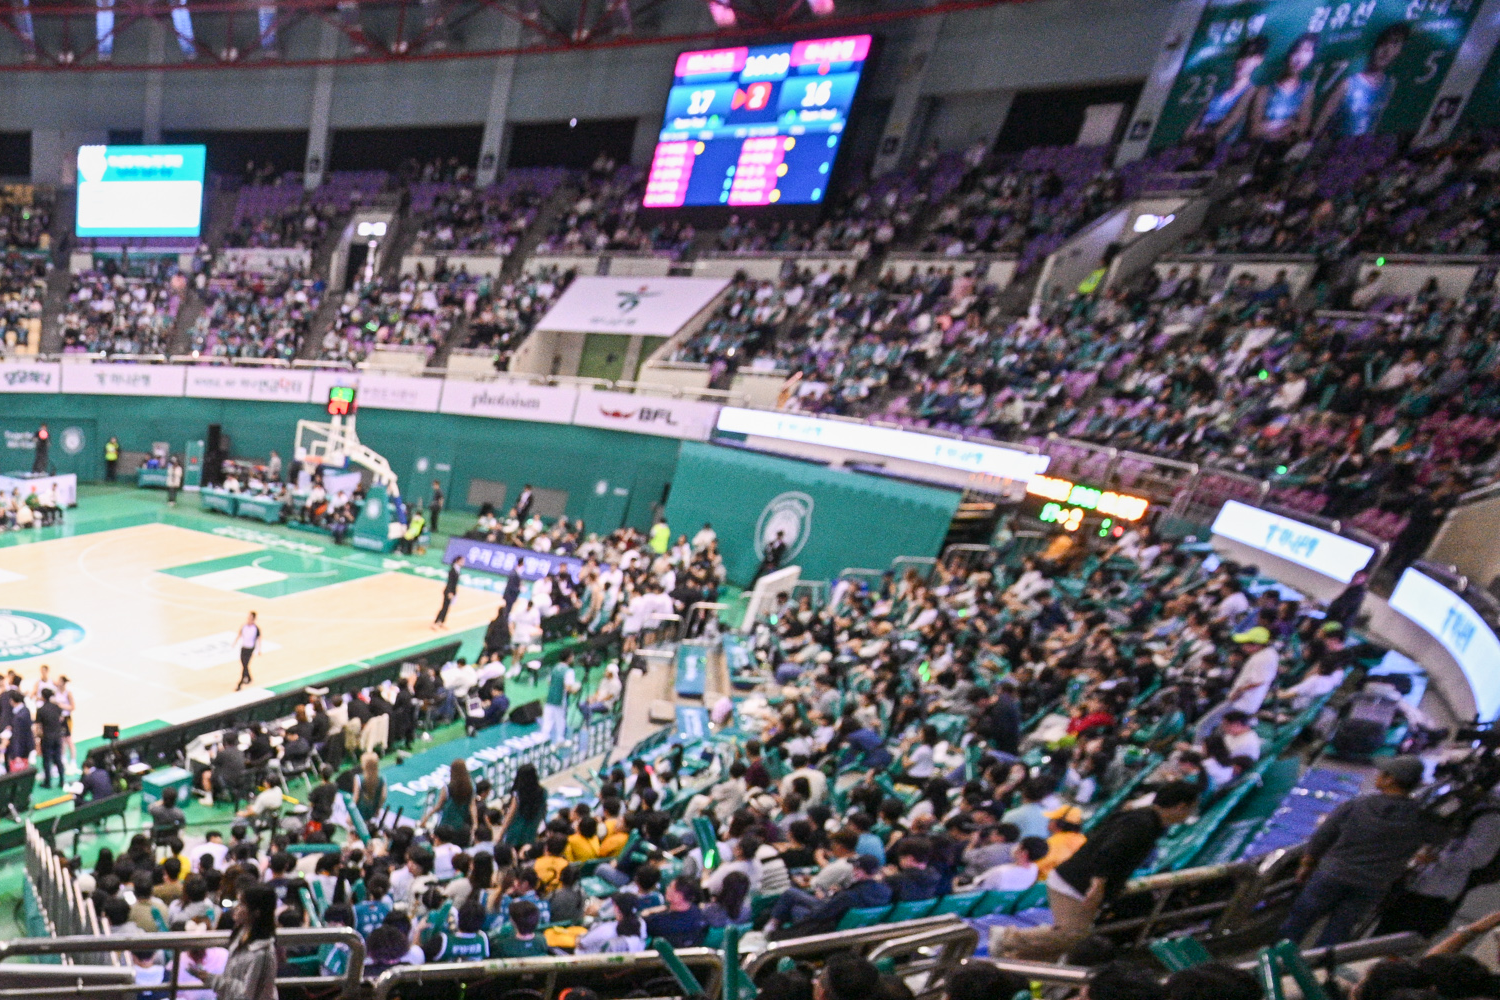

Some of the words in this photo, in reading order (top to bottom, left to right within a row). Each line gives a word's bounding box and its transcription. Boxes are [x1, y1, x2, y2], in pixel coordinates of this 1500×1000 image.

[687, 89, 716, 115] 17
[748, 85, 766, 109] 2
[800, 80, 833, 107] 16
[638, 406, 678, 426] BFL
